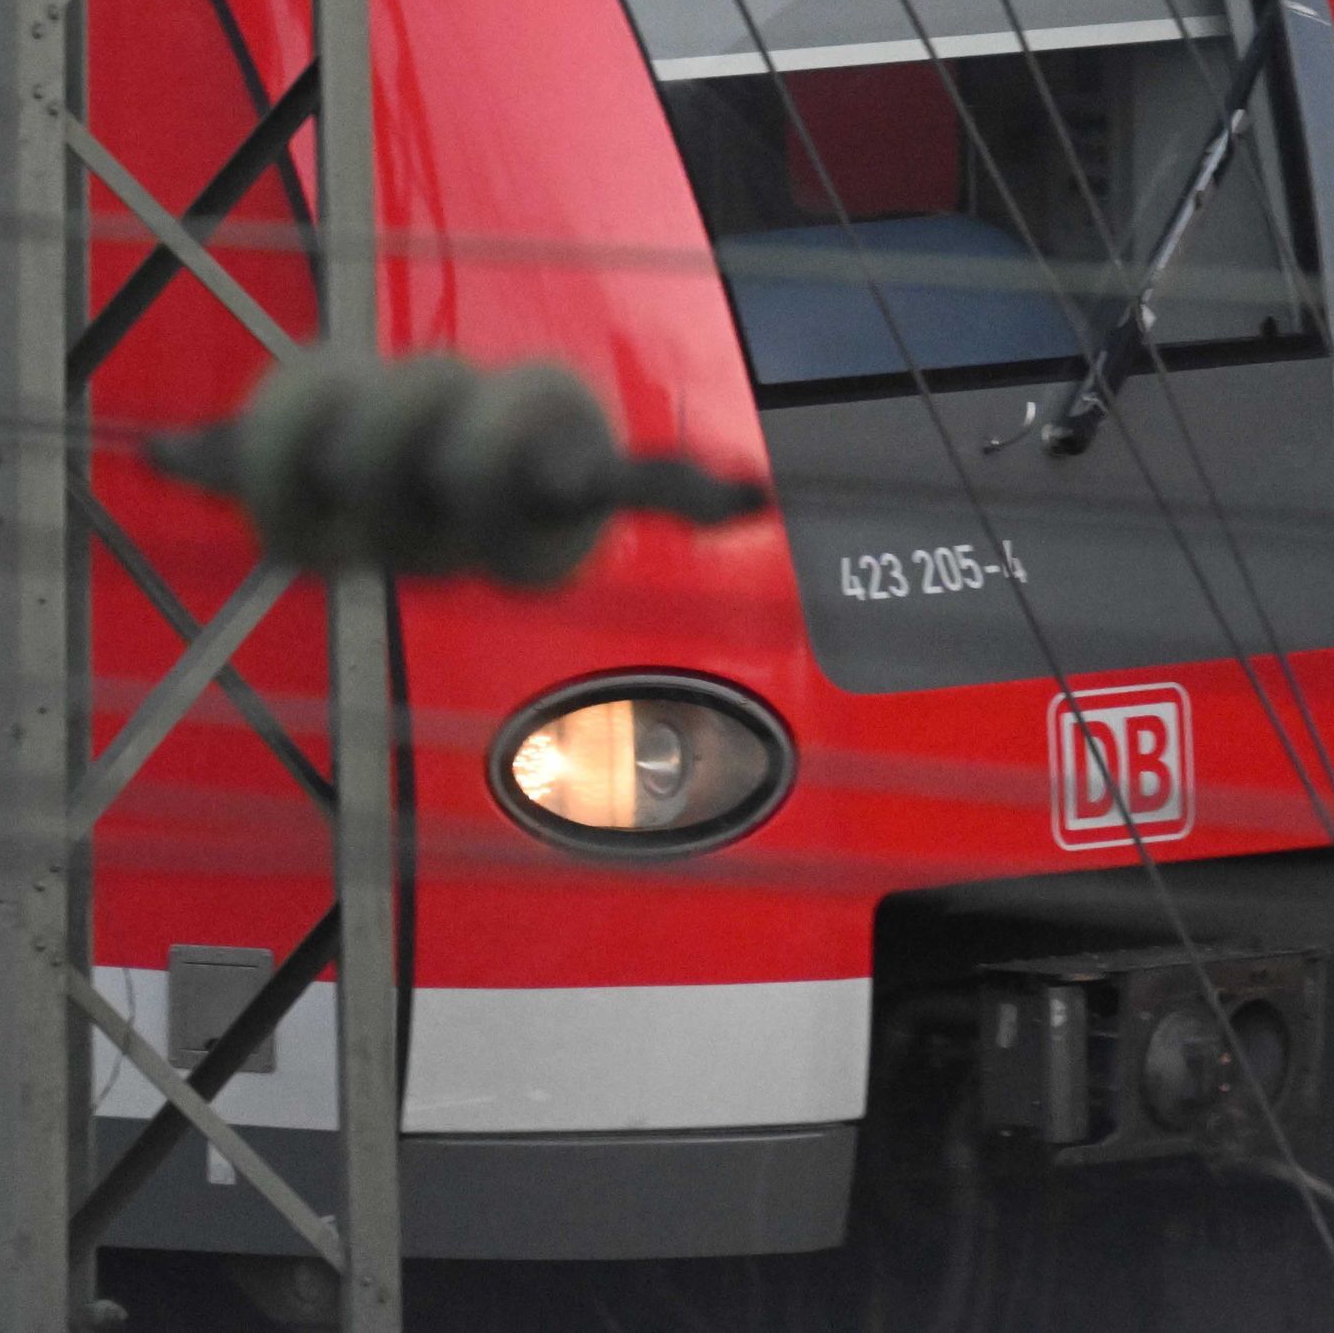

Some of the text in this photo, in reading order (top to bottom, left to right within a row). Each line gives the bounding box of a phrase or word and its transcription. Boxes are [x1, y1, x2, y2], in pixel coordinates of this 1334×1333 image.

[841, 539, 1028, 601] 423 205-4
[1072, 714, 1173, 820] DB
